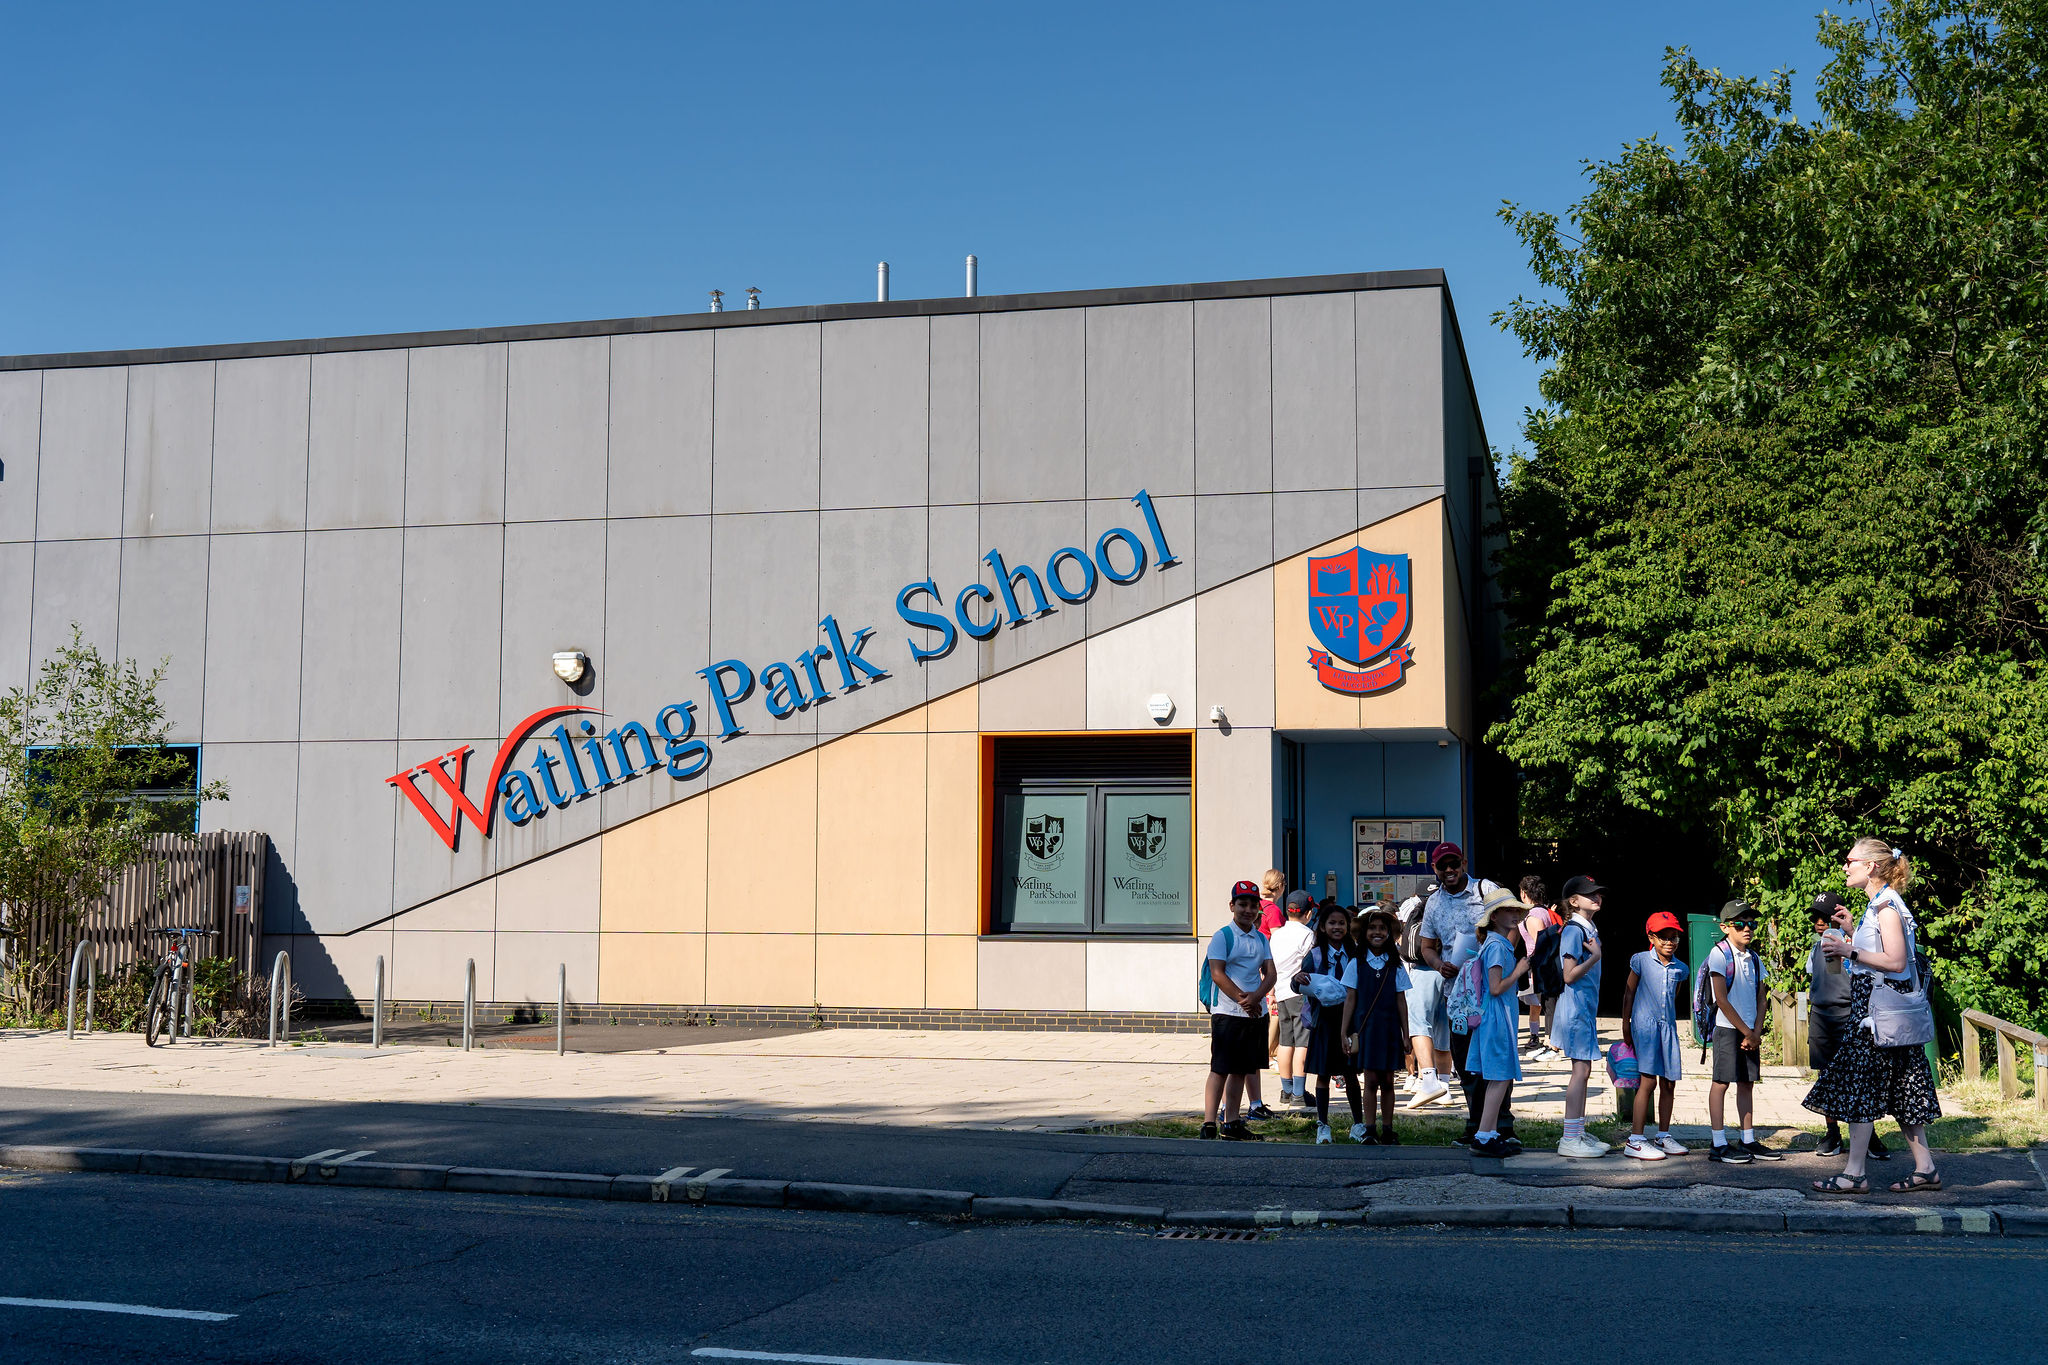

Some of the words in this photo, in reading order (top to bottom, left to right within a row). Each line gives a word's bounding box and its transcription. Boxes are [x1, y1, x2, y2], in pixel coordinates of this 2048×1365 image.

[1314, 605, 1354, 639] WP
[386, 704, 708, 850] Watling
[696, 614, 888, 739] Park
[896, 488, 1178, 662] School
[1012, 876, 1053, 893] Watling
[1112, 876, 1155, 894] Watling
[1029, 890, 1048, 899] Park
[1049, 890, 1077, 899] School
[1131, 891, 1150, 900] Park
[1151, 891, 1180, 900] School
